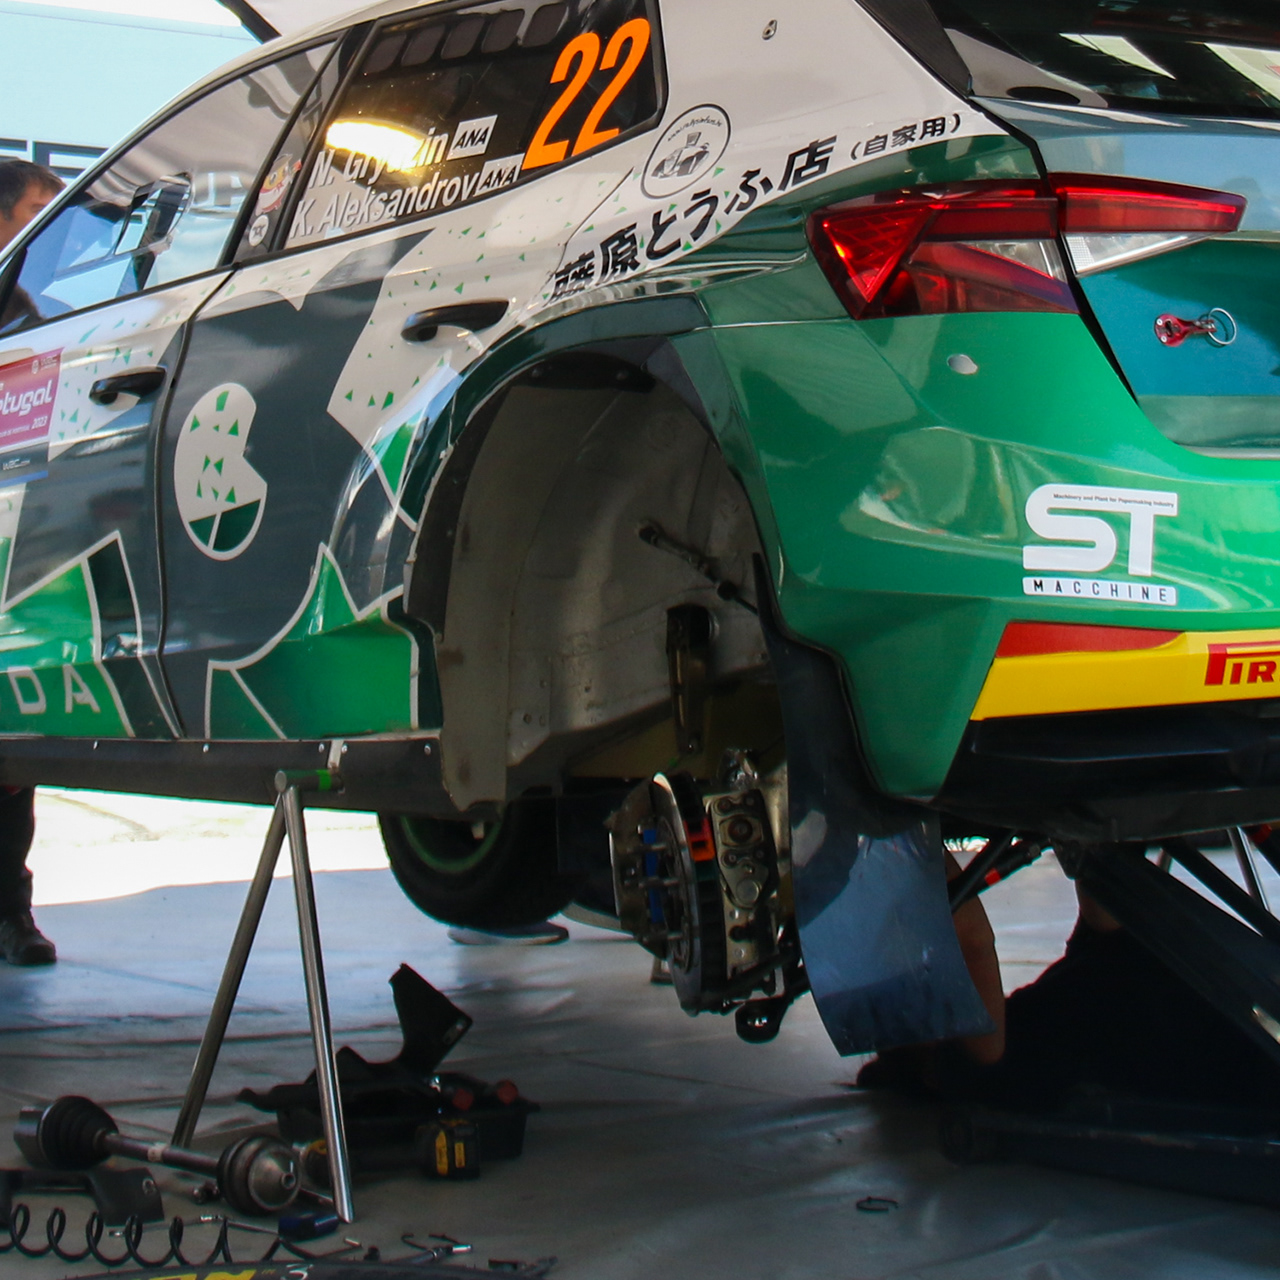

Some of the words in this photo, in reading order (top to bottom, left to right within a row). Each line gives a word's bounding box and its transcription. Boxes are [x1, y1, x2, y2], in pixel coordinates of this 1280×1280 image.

[521, 17, 651, 171] 22
[456, 125, 489, 149] ANA
[289, 198, 313, 239] K.
[317, 170, 480, 233] Aleksandrov
[1033, 579, 1167, 602] MACCHINE
